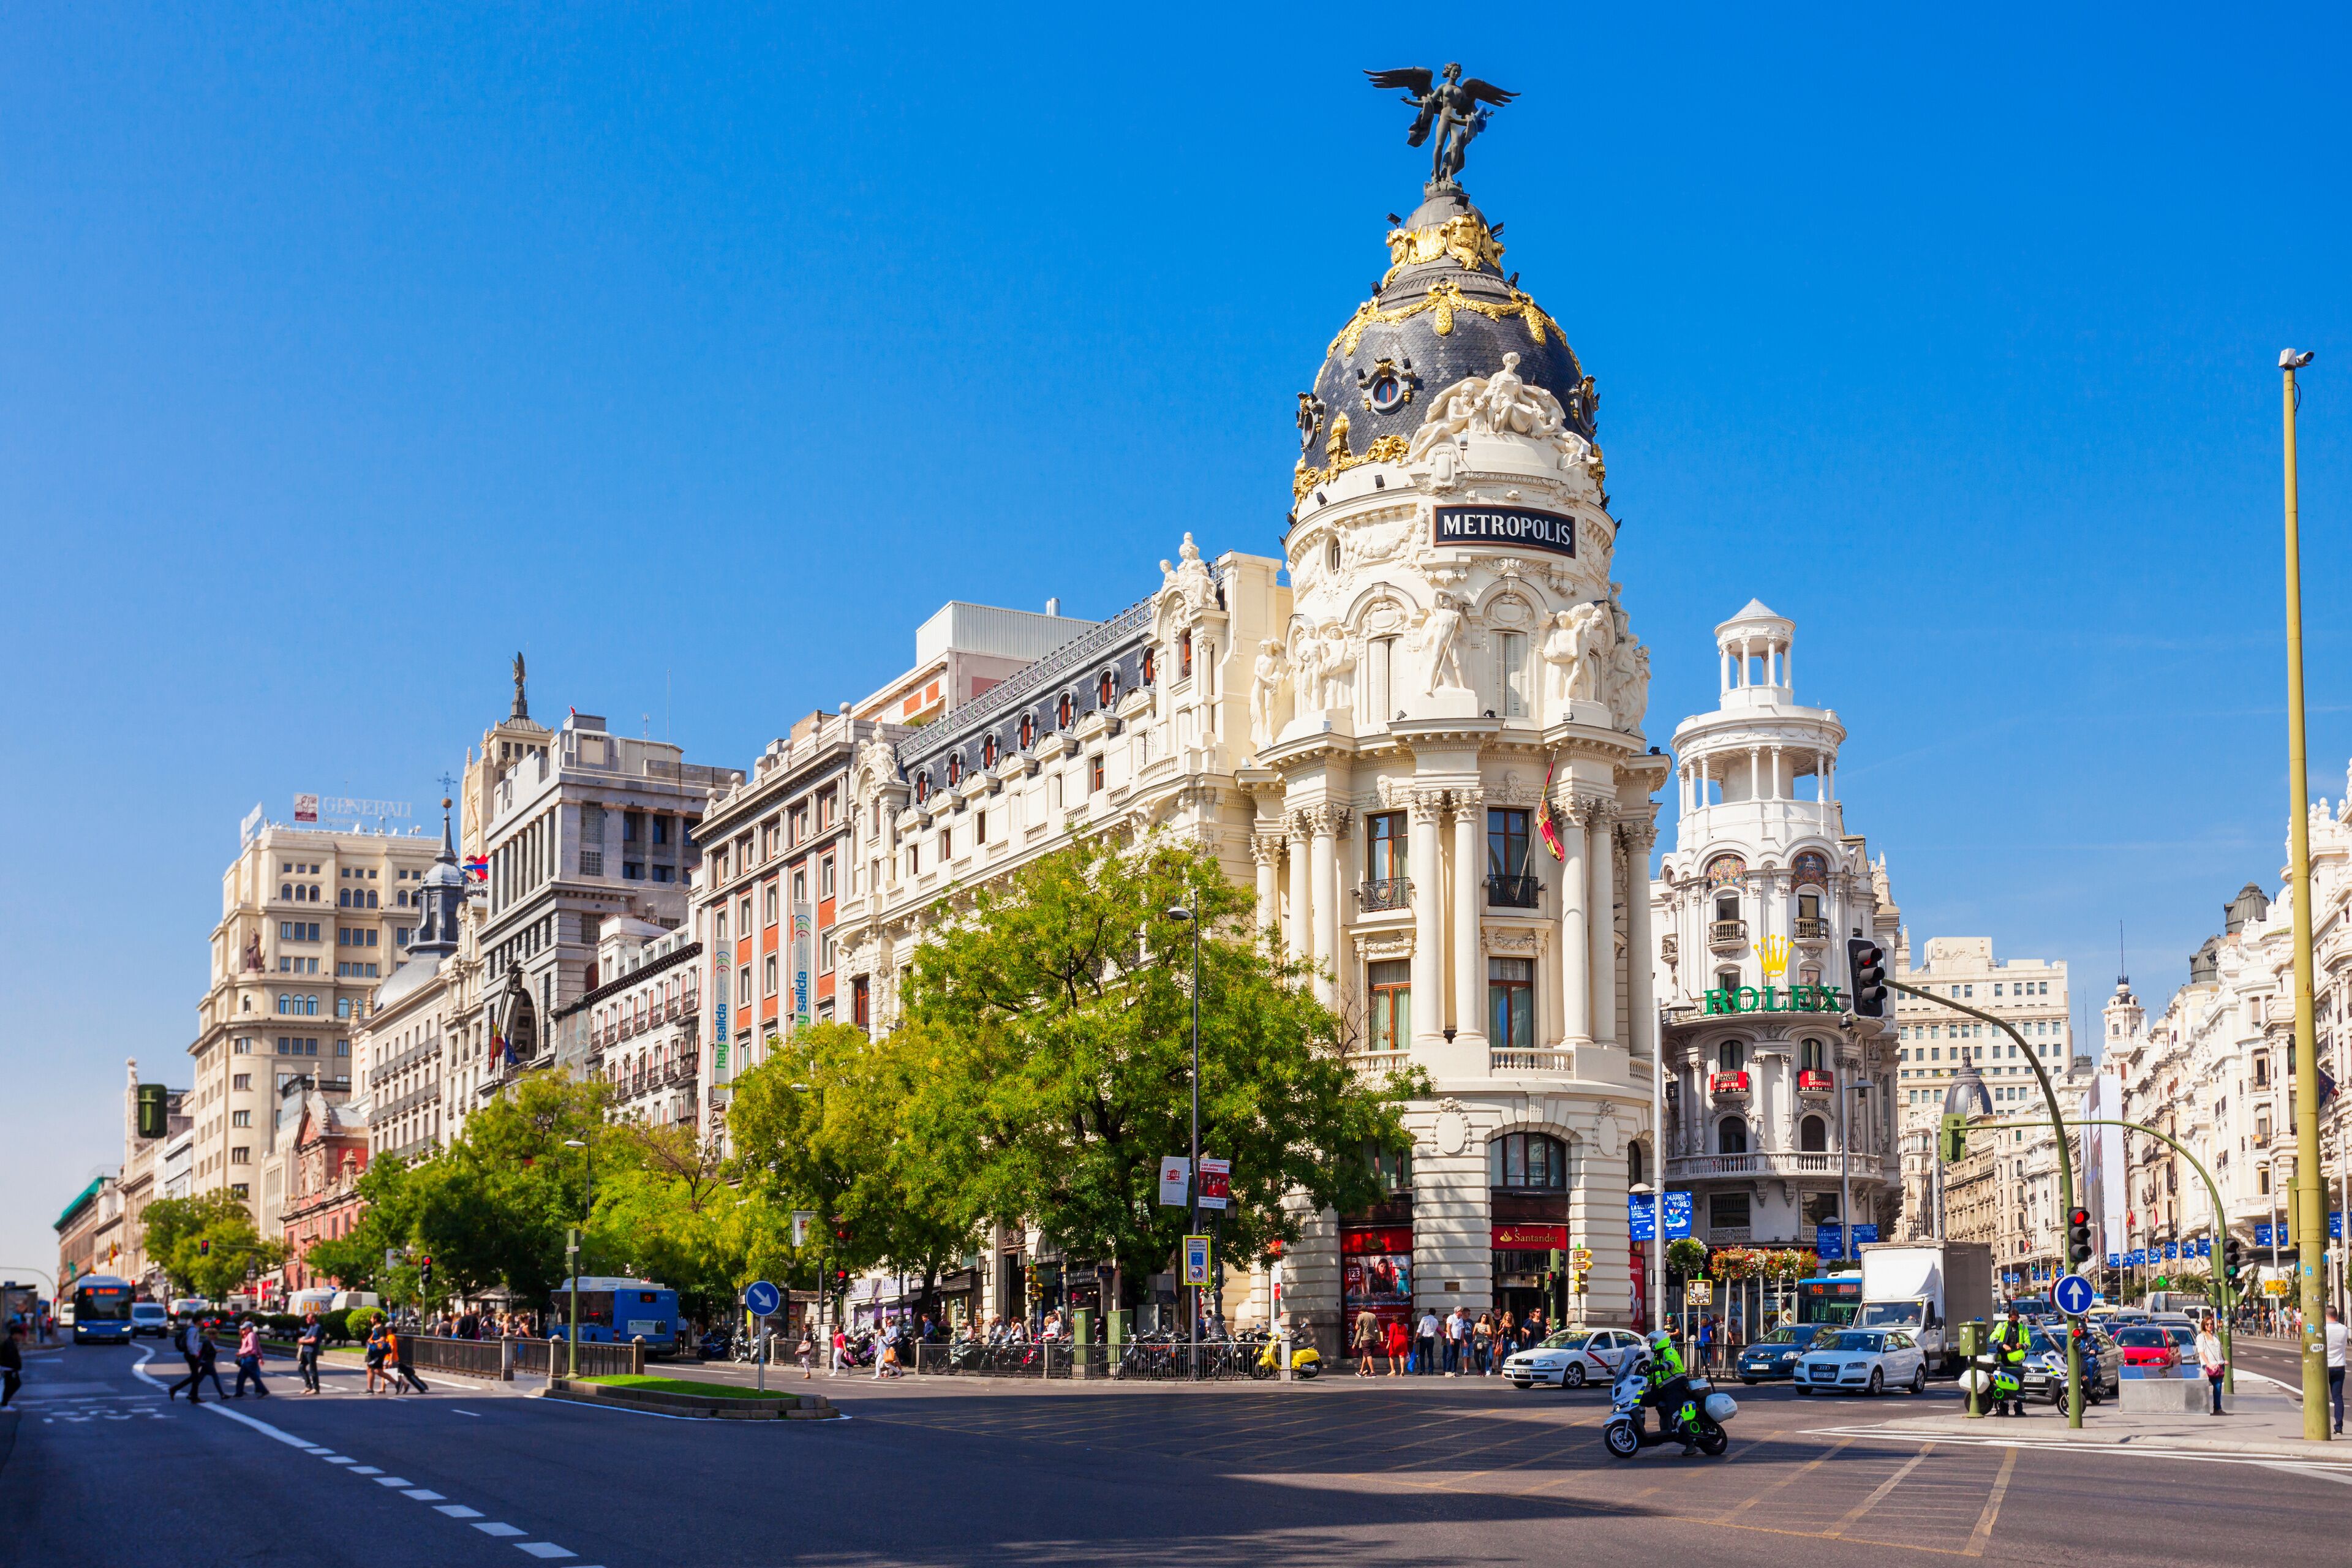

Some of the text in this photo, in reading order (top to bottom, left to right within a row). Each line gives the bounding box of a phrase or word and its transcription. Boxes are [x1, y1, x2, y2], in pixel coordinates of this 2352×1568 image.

[1443, 514, 1571, 546] METROPOLIS
[323, 796, 412, 818] GENERALI
[796, 971, 807, 1012] salida
[1703, 985, 1846, 1015] ROLEX
[715, 1003, 729, 1069] hay salida
[1515, 1233, 1559, 1242] Santander
[1812, 1284, 1823, 1294] 46
[303, 1300, 331, 1313] FLAX
